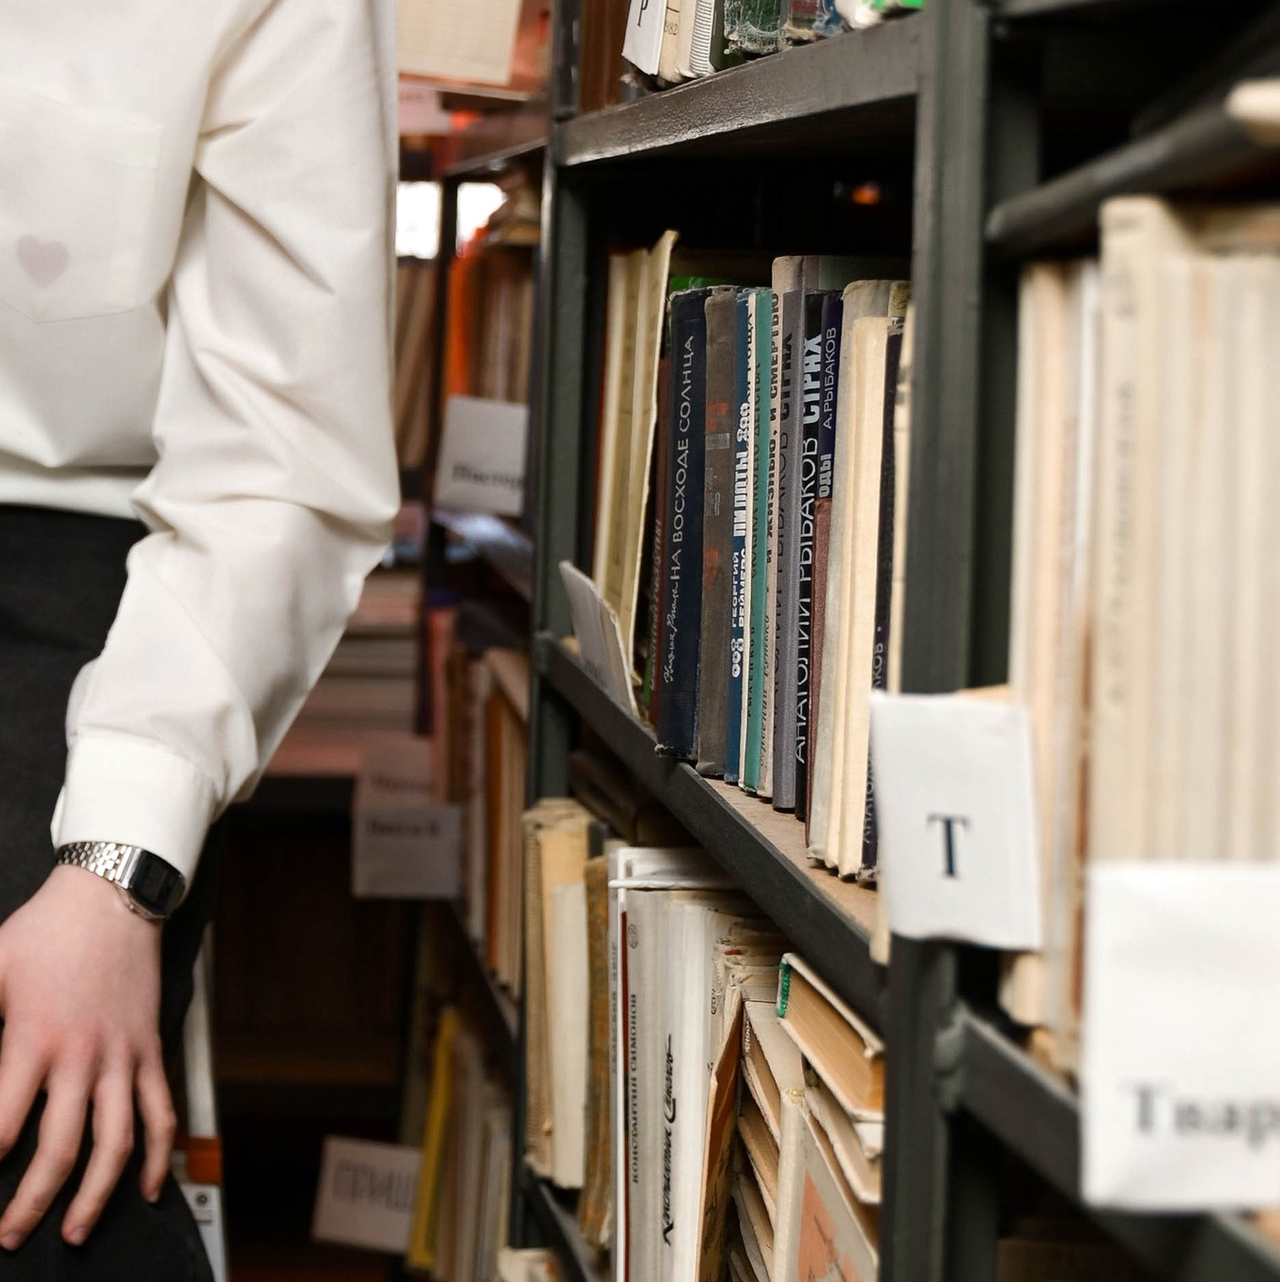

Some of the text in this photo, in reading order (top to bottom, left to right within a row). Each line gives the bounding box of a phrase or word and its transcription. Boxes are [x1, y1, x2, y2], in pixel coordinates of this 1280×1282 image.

[679, 334, 695, 433] СОЛНЦА
[770, 292, 780, 399] СМЕРТЬЮ
[802, 332, 823, 425] СТРАХ
[820, 326, 837, 498] ОДЫ А.РЫБАКОВ
[672, 438, 690, 543] ВОСХОДЕ
[733, 450, 748, 537] ПИЛОТЫ
[798, 437, 819, 583] РЫБАКОВ
[671, 548, 682, 580] НА
[731, 550, 740, 628] ГЕОРГИЙ
[927, 815, 971, 880] Т
[629, 994, 639, 1184] КОНСТАНТИН СИМОНОВ
